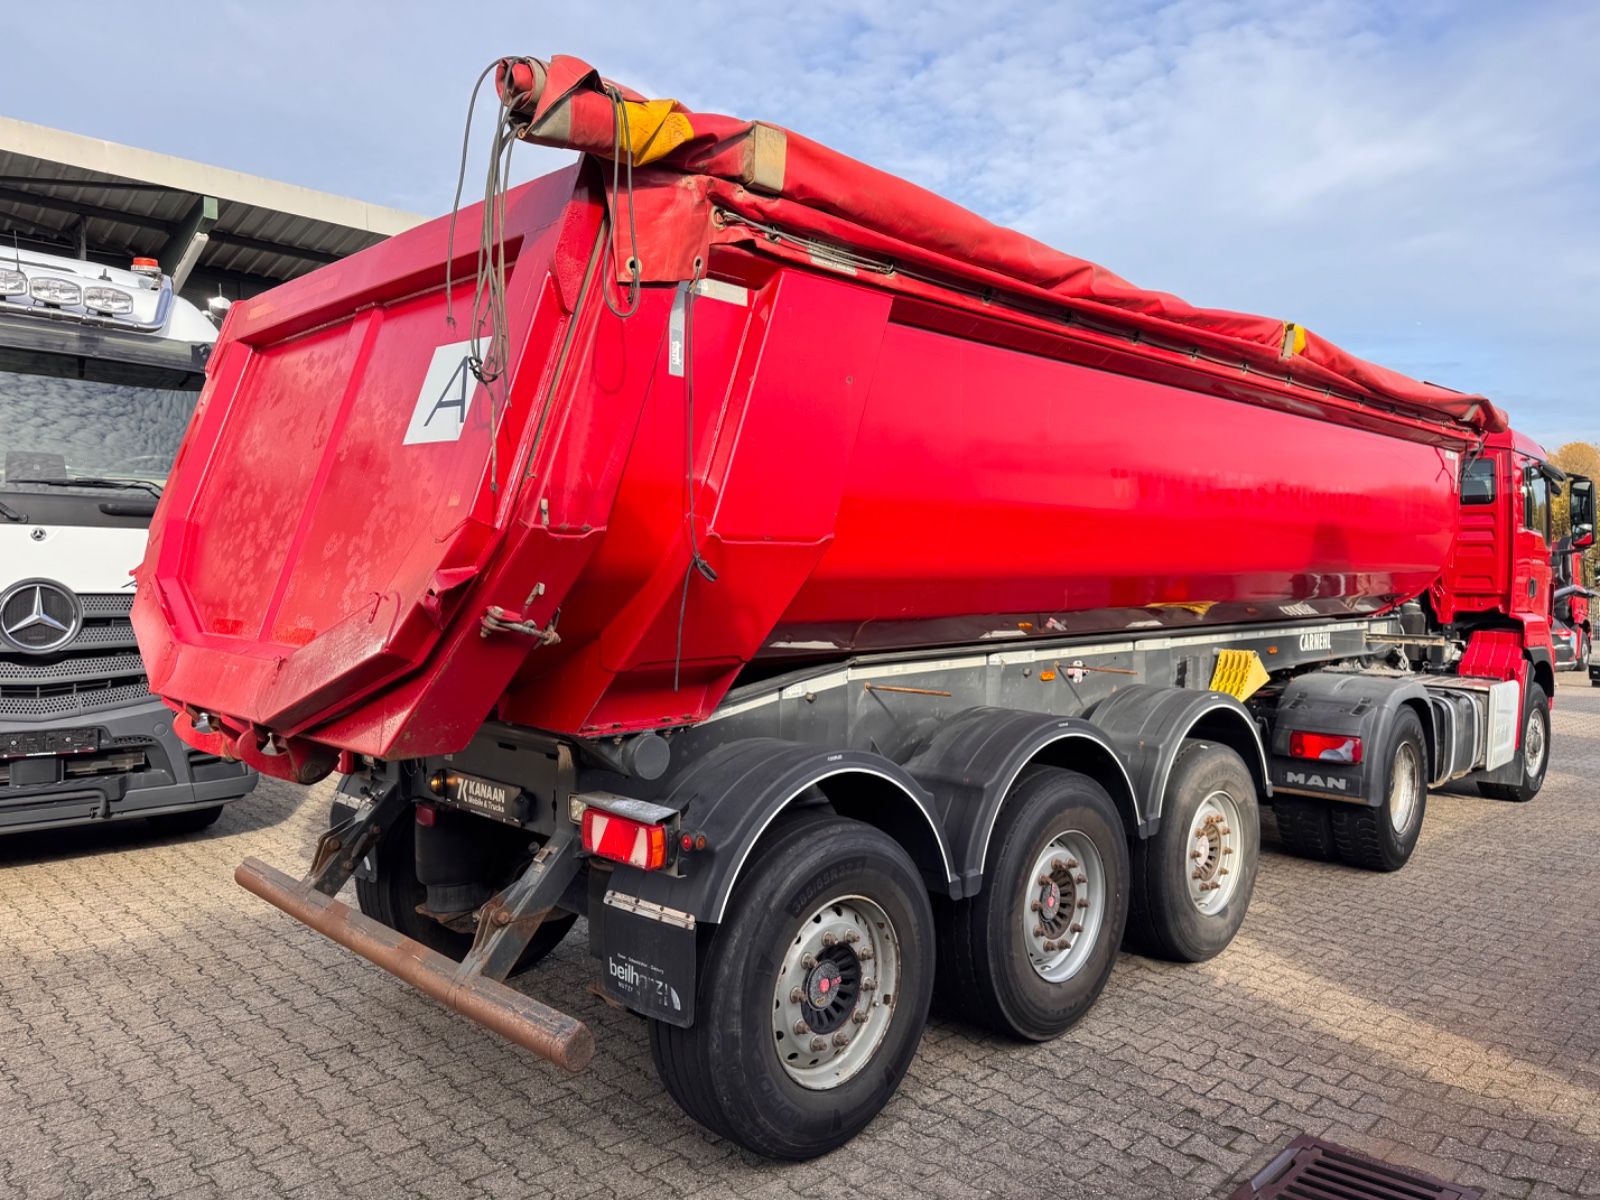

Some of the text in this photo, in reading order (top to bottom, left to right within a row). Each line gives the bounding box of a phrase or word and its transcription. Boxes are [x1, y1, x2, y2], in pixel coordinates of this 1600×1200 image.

[423, 355, 469, 427] A
[1299, 632, 1331, 652] CARNEHL
[1286, 771, 1347, 790] MAN
[469, 781, 505, 803] KANAAN
